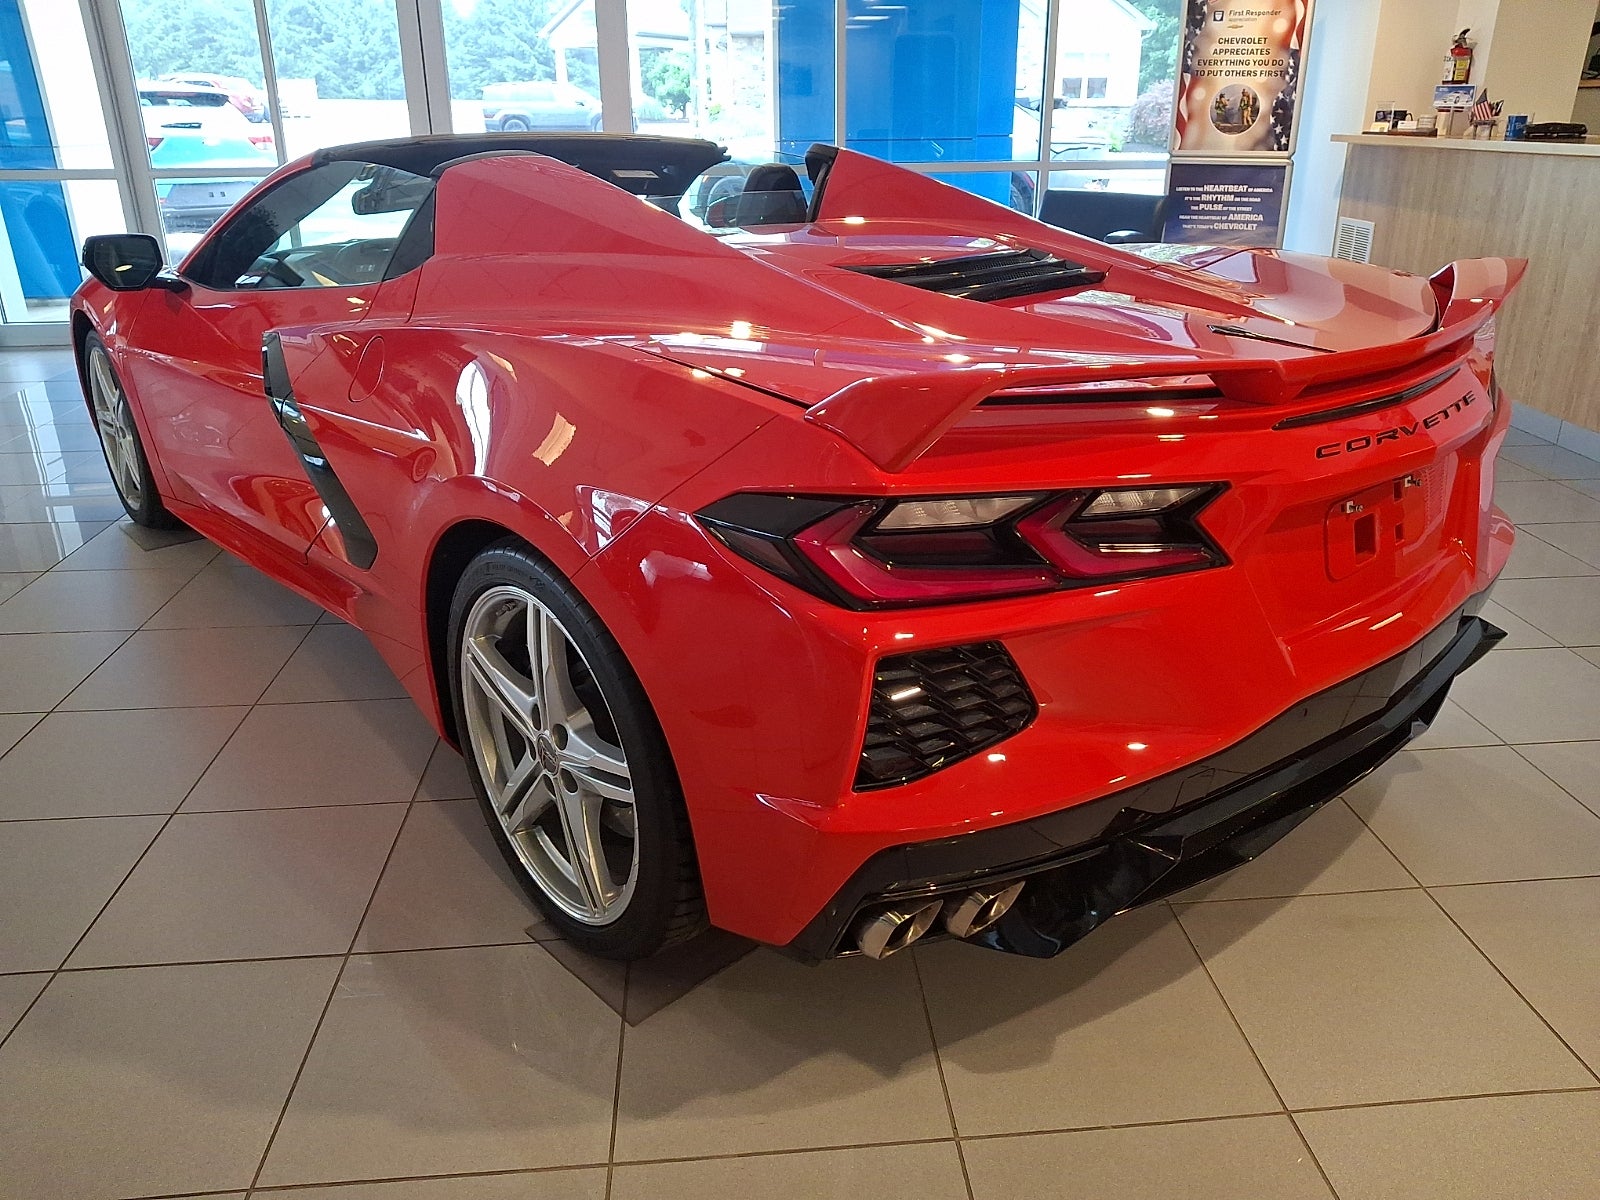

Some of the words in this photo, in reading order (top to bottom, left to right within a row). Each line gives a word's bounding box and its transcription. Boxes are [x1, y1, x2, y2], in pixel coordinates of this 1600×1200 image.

[1245, 9, 1282, 17] Responder
[1218, 37, 1268, 45] CHEVROLET
[1212, 48, 1271, 56] APPRECIATES
[1197, 59, 1251, 67] EVERYTHING
[1252, 59, 1270, 67] YOU
[1271, 59, 1284, 67] DO
[1259, 70, 1285, 78] FIRST
[1203, 184, 1248, 192] HEARTBEAT
[1201, 194, 1234, 202] RHYTHM
[1199, 203, 1223, 211] PULSE
[1228, 213, 1264, 222] AMERICA
[1213, 222, 1258, 231] CHEVROLET
[1315, 390, 1476, 459] CORVETTE
